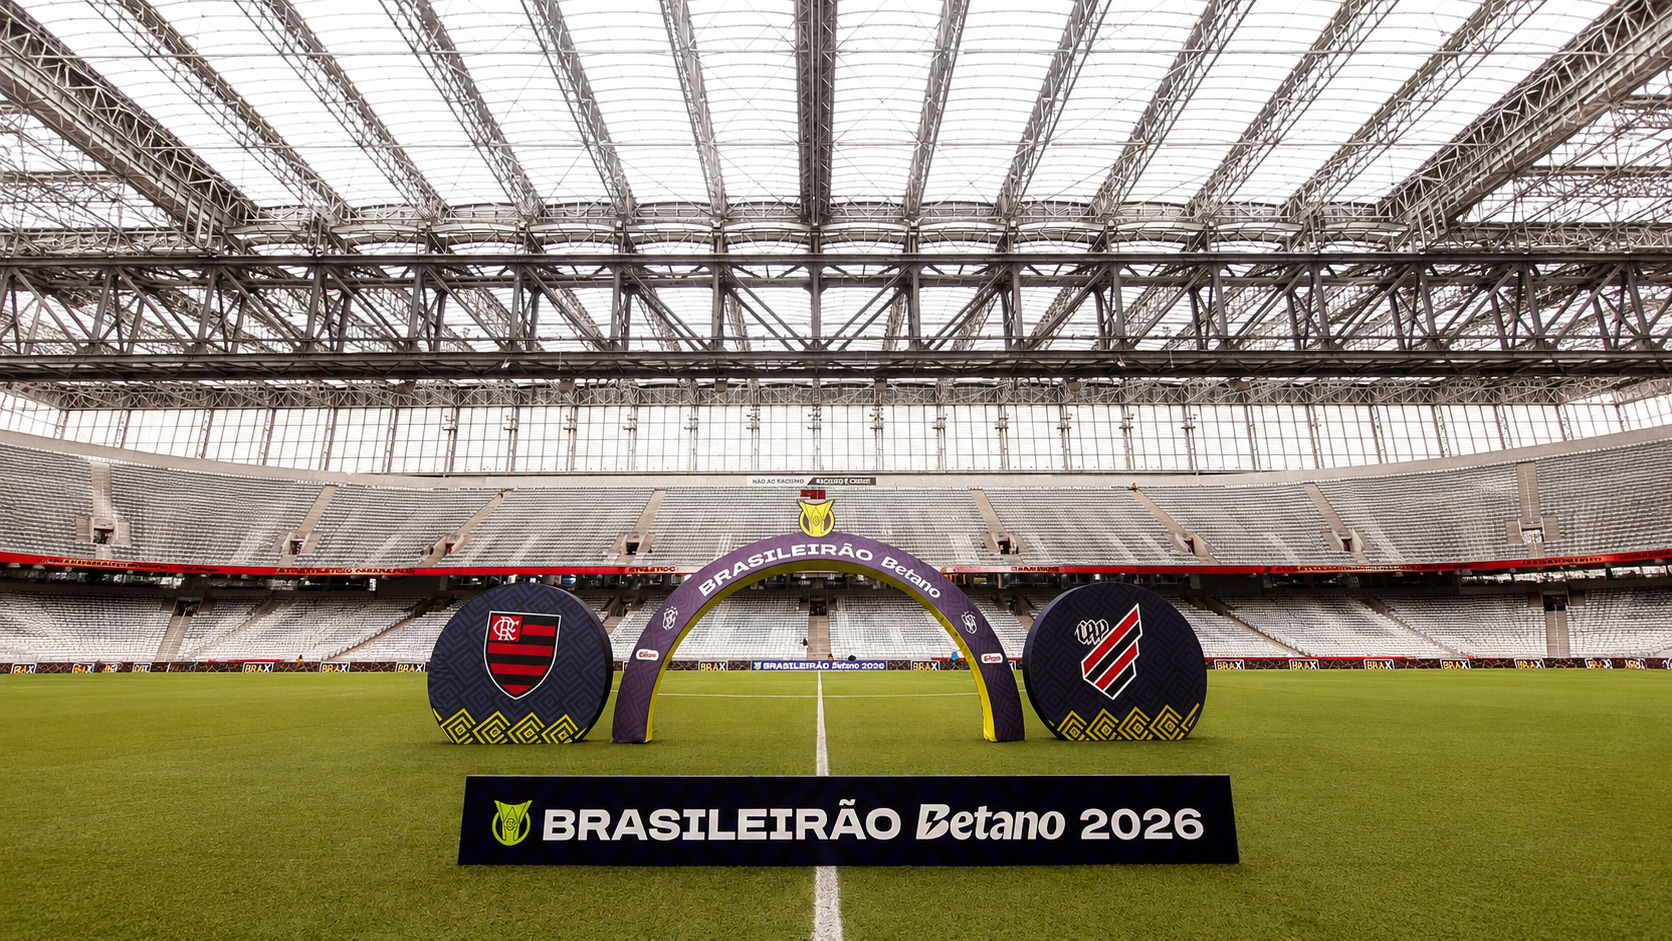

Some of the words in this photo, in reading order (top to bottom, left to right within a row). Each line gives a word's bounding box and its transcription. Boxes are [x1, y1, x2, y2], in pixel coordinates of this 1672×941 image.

[698, 543, 873, 597] BRASILEIRÃO
[881, 556, 941, 599] Betano
[245, 664, 271, 673] BRAX
[322, 664, 348, 672] BRAX
[398, 664, 423, 672] BRAX
[701, 663, 726, 671] BRAX
[913, 662, 938, 671] BRAX
[1217, 661, 1242, 670] BRAX
[1367, 661, 1392, 669] BRAX
[1443, 661, 1468, 669] BRAX
[543, 799, 902, 841] BRASILEIRÃO
[916, 804, 1066, 841] Betano
[1080, 808, 1204, 841] 2026
